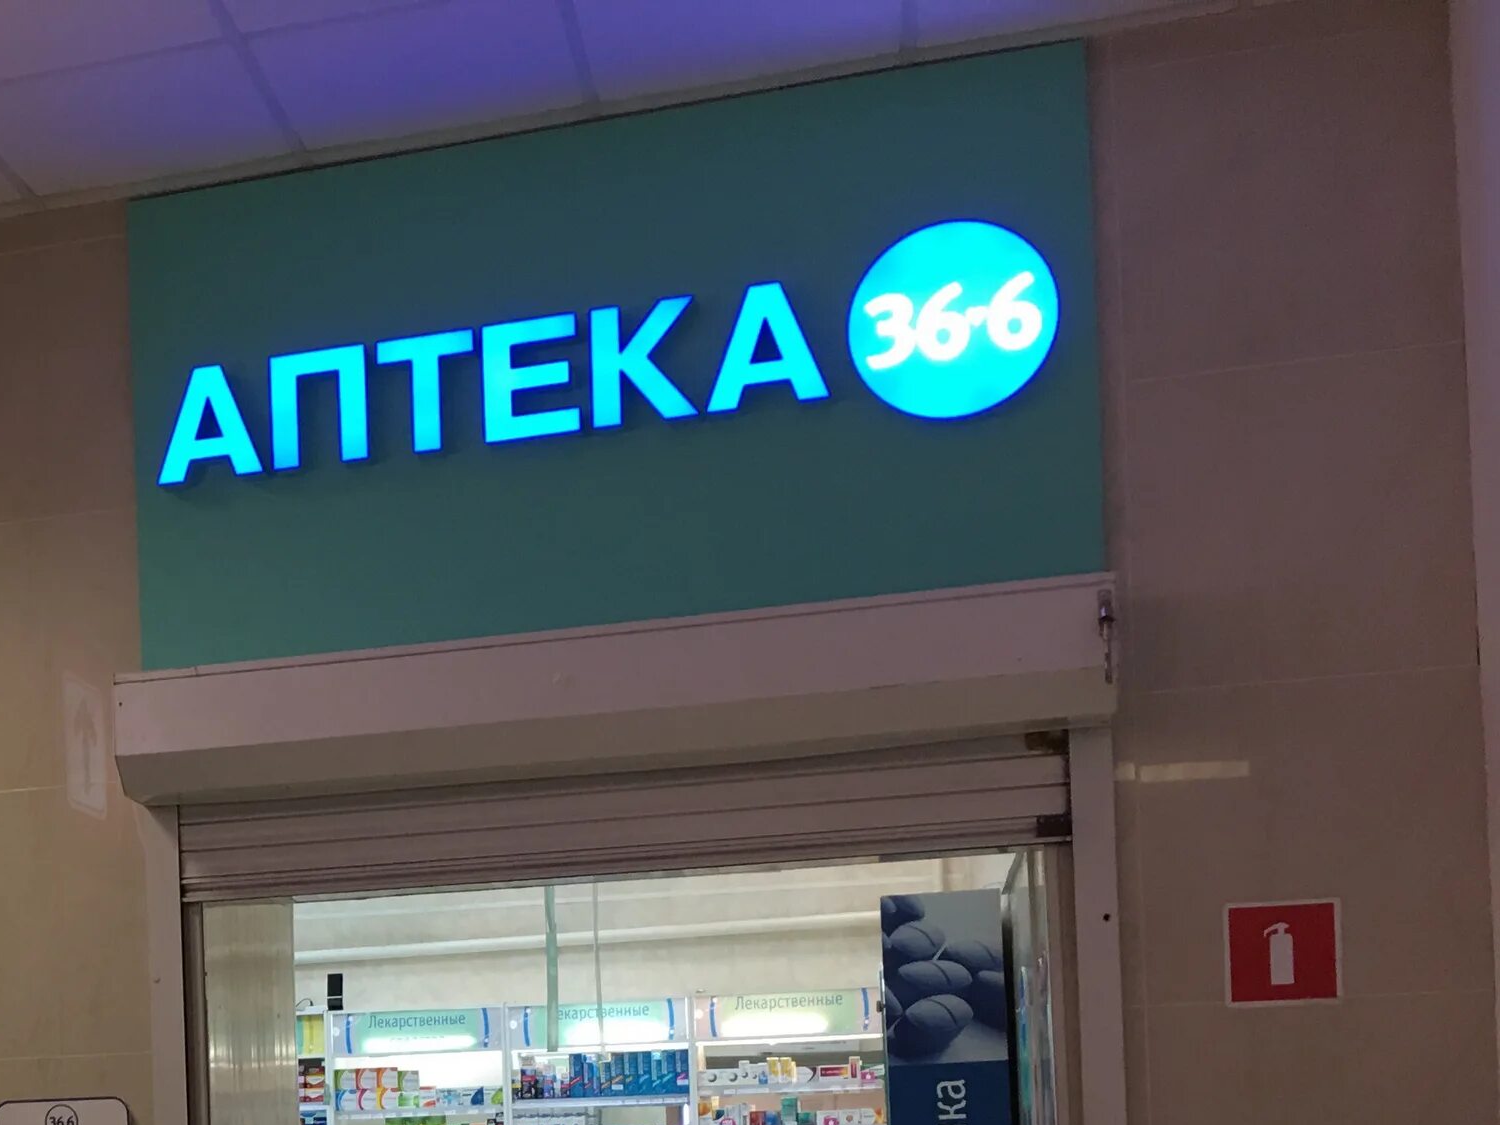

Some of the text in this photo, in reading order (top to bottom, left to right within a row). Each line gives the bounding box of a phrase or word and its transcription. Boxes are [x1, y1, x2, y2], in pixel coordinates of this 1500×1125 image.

[156, 280, 831, 487] АПТЕКА
[735, 993, 844, 1012] Лекарственные
[368, 1012, 467, 1030] Лекарственные
[555, 1005, 650, 1022] екарственные
